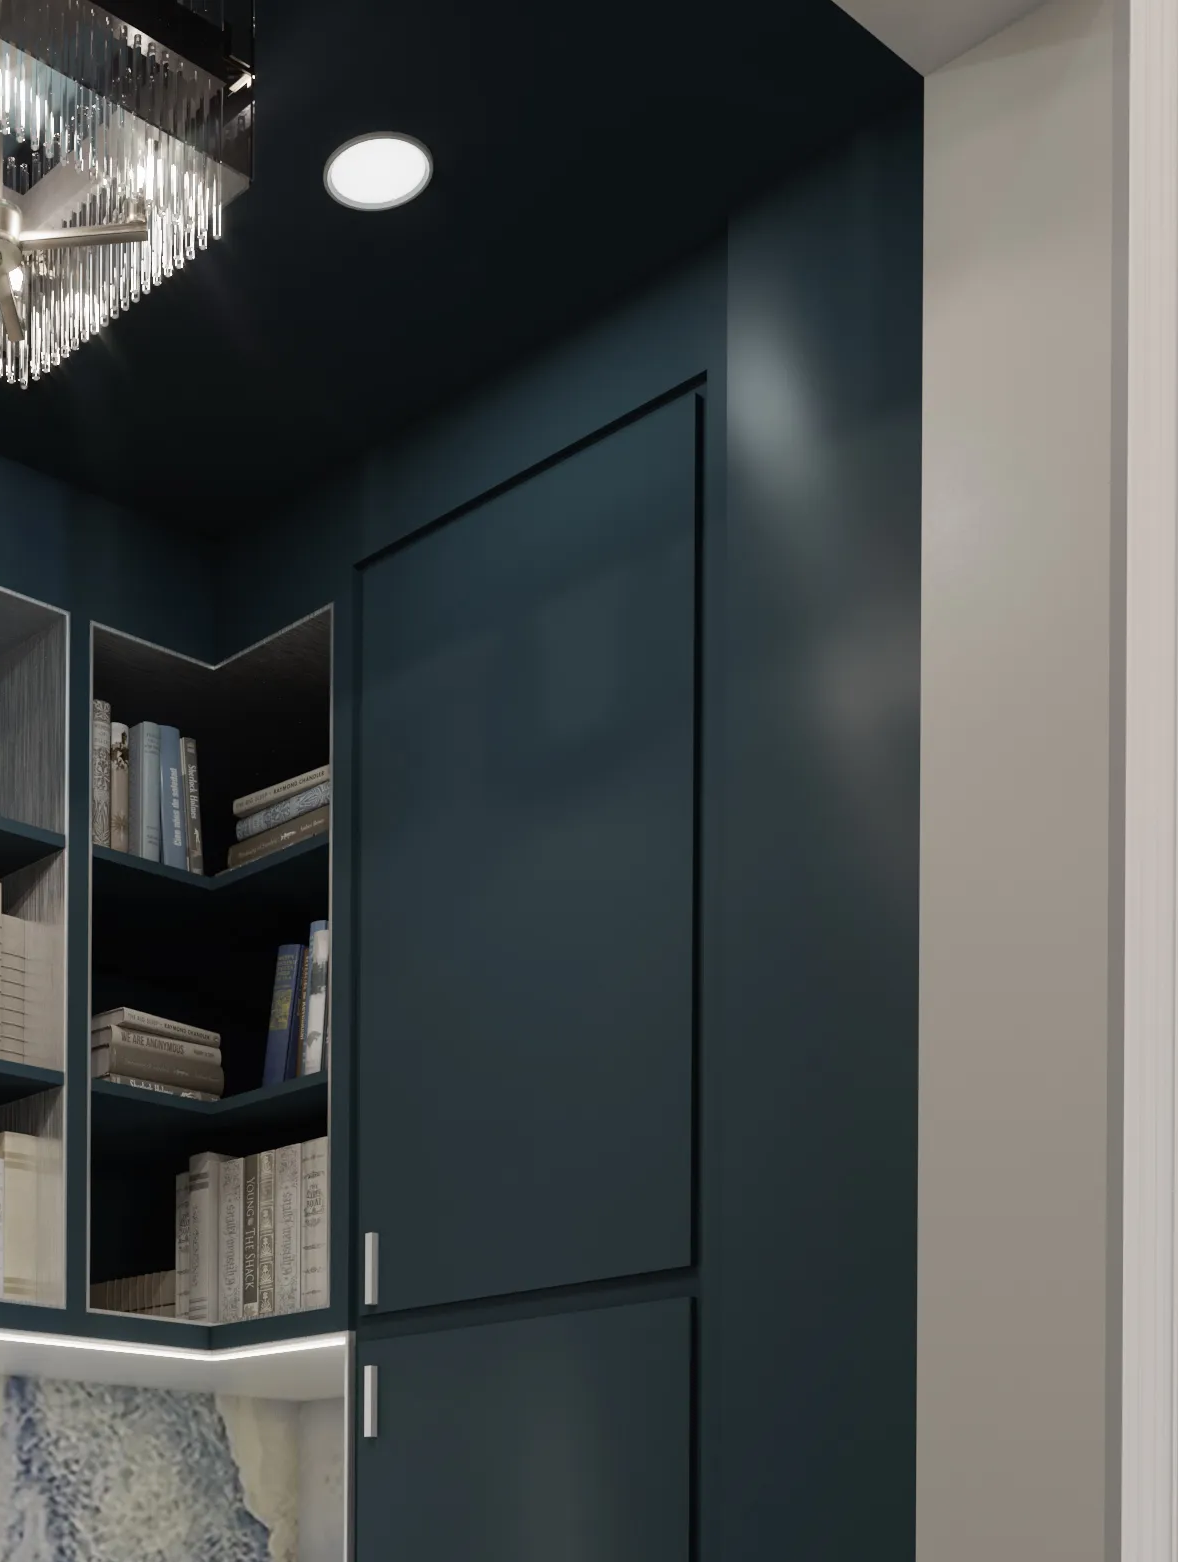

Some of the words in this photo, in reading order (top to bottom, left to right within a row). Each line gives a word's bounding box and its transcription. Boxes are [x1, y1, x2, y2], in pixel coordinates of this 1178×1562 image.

[187, 764, 197, 793] Sherlock
[189, 795, 199, 819] Holmes
[164, 1022, 187, 1034] RAYMOND
[188, 1028, 210, 1040] CHANDLER
[122, 1032, 131, 1042] WE
[132, 1034, 145, 1045] ARE
[146, 1037, 184, 1055] ANONYMOUS
[246, 1177, 256, 1222] YOUNG
[246, 1228, 256, 1251] THE
[245, 1252, 256, 1289] SHACK
